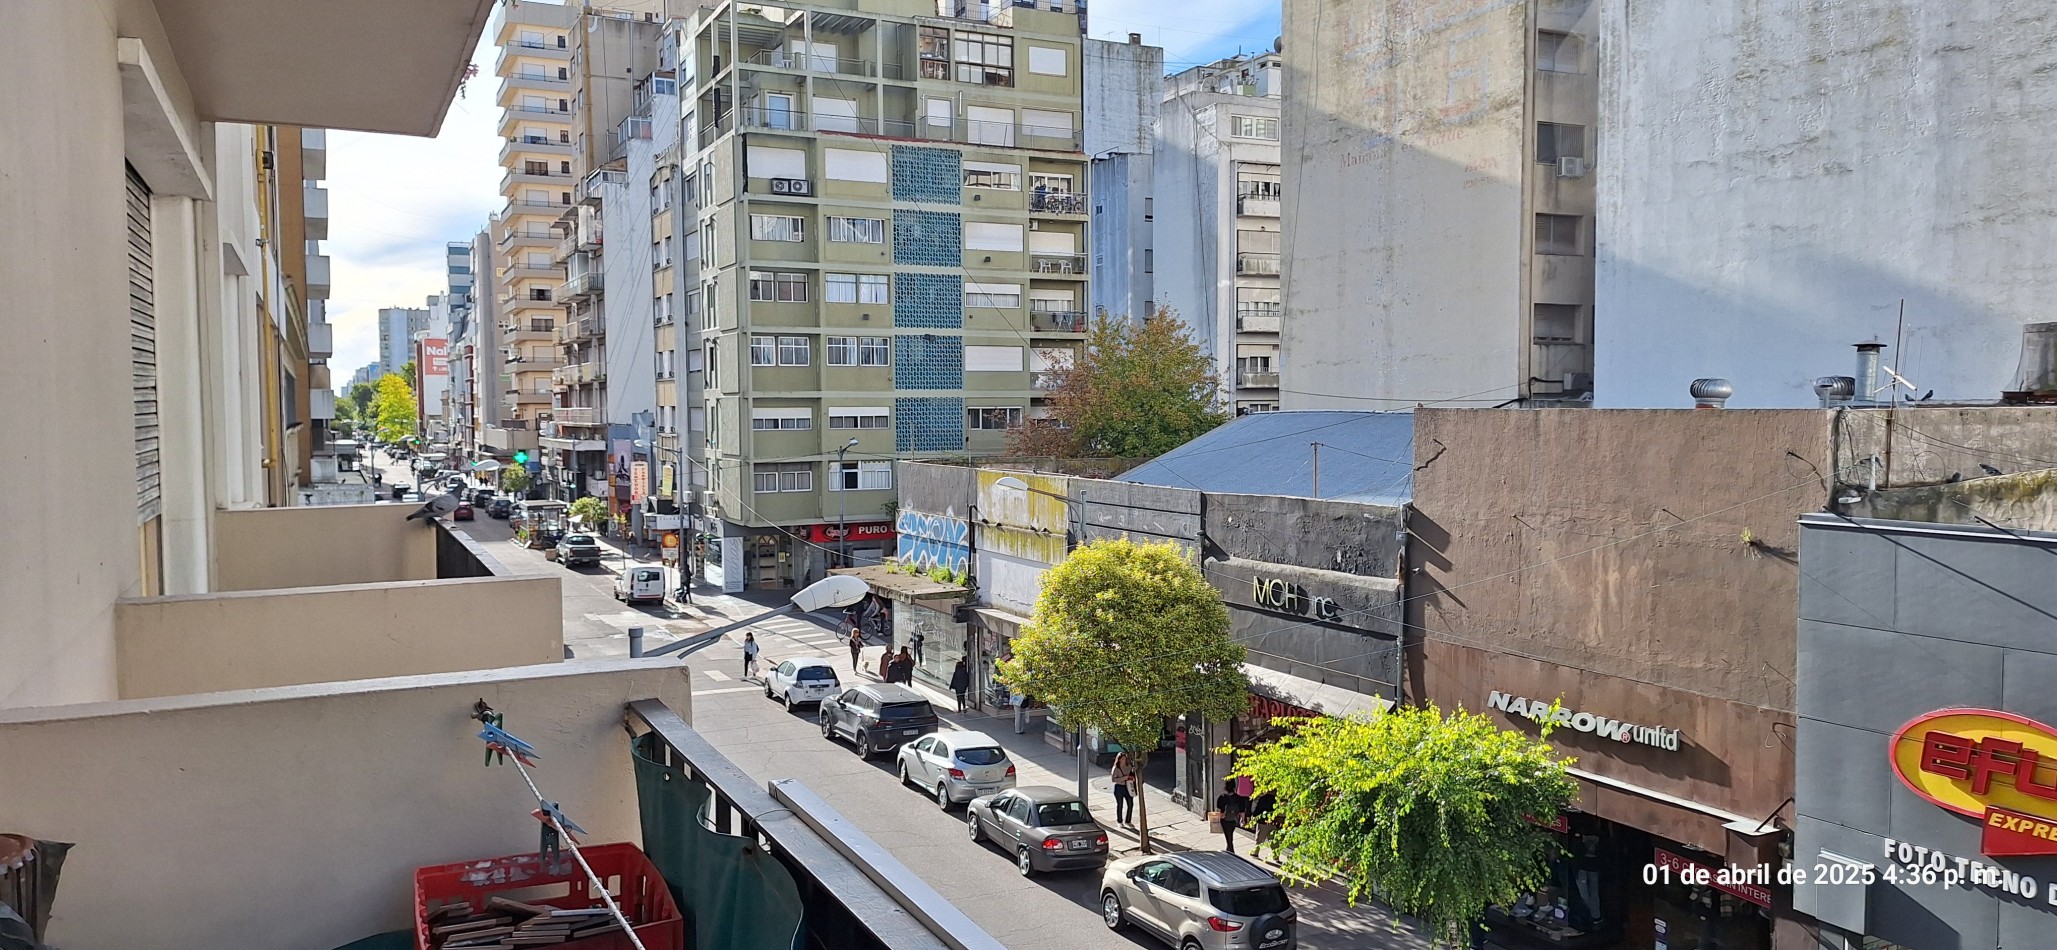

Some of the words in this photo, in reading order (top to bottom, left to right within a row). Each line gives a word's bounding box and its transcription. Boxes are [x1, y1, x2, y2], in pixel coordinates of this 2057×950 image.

[858, 525, 888, 535] PURO
[1253, 575, 1298, 611] MOH
[1486, 690, 1634, 741] NARROW
[1660, 853, 1679, 870] 3-6
[1884, 838, 1946, 873] FOTO
